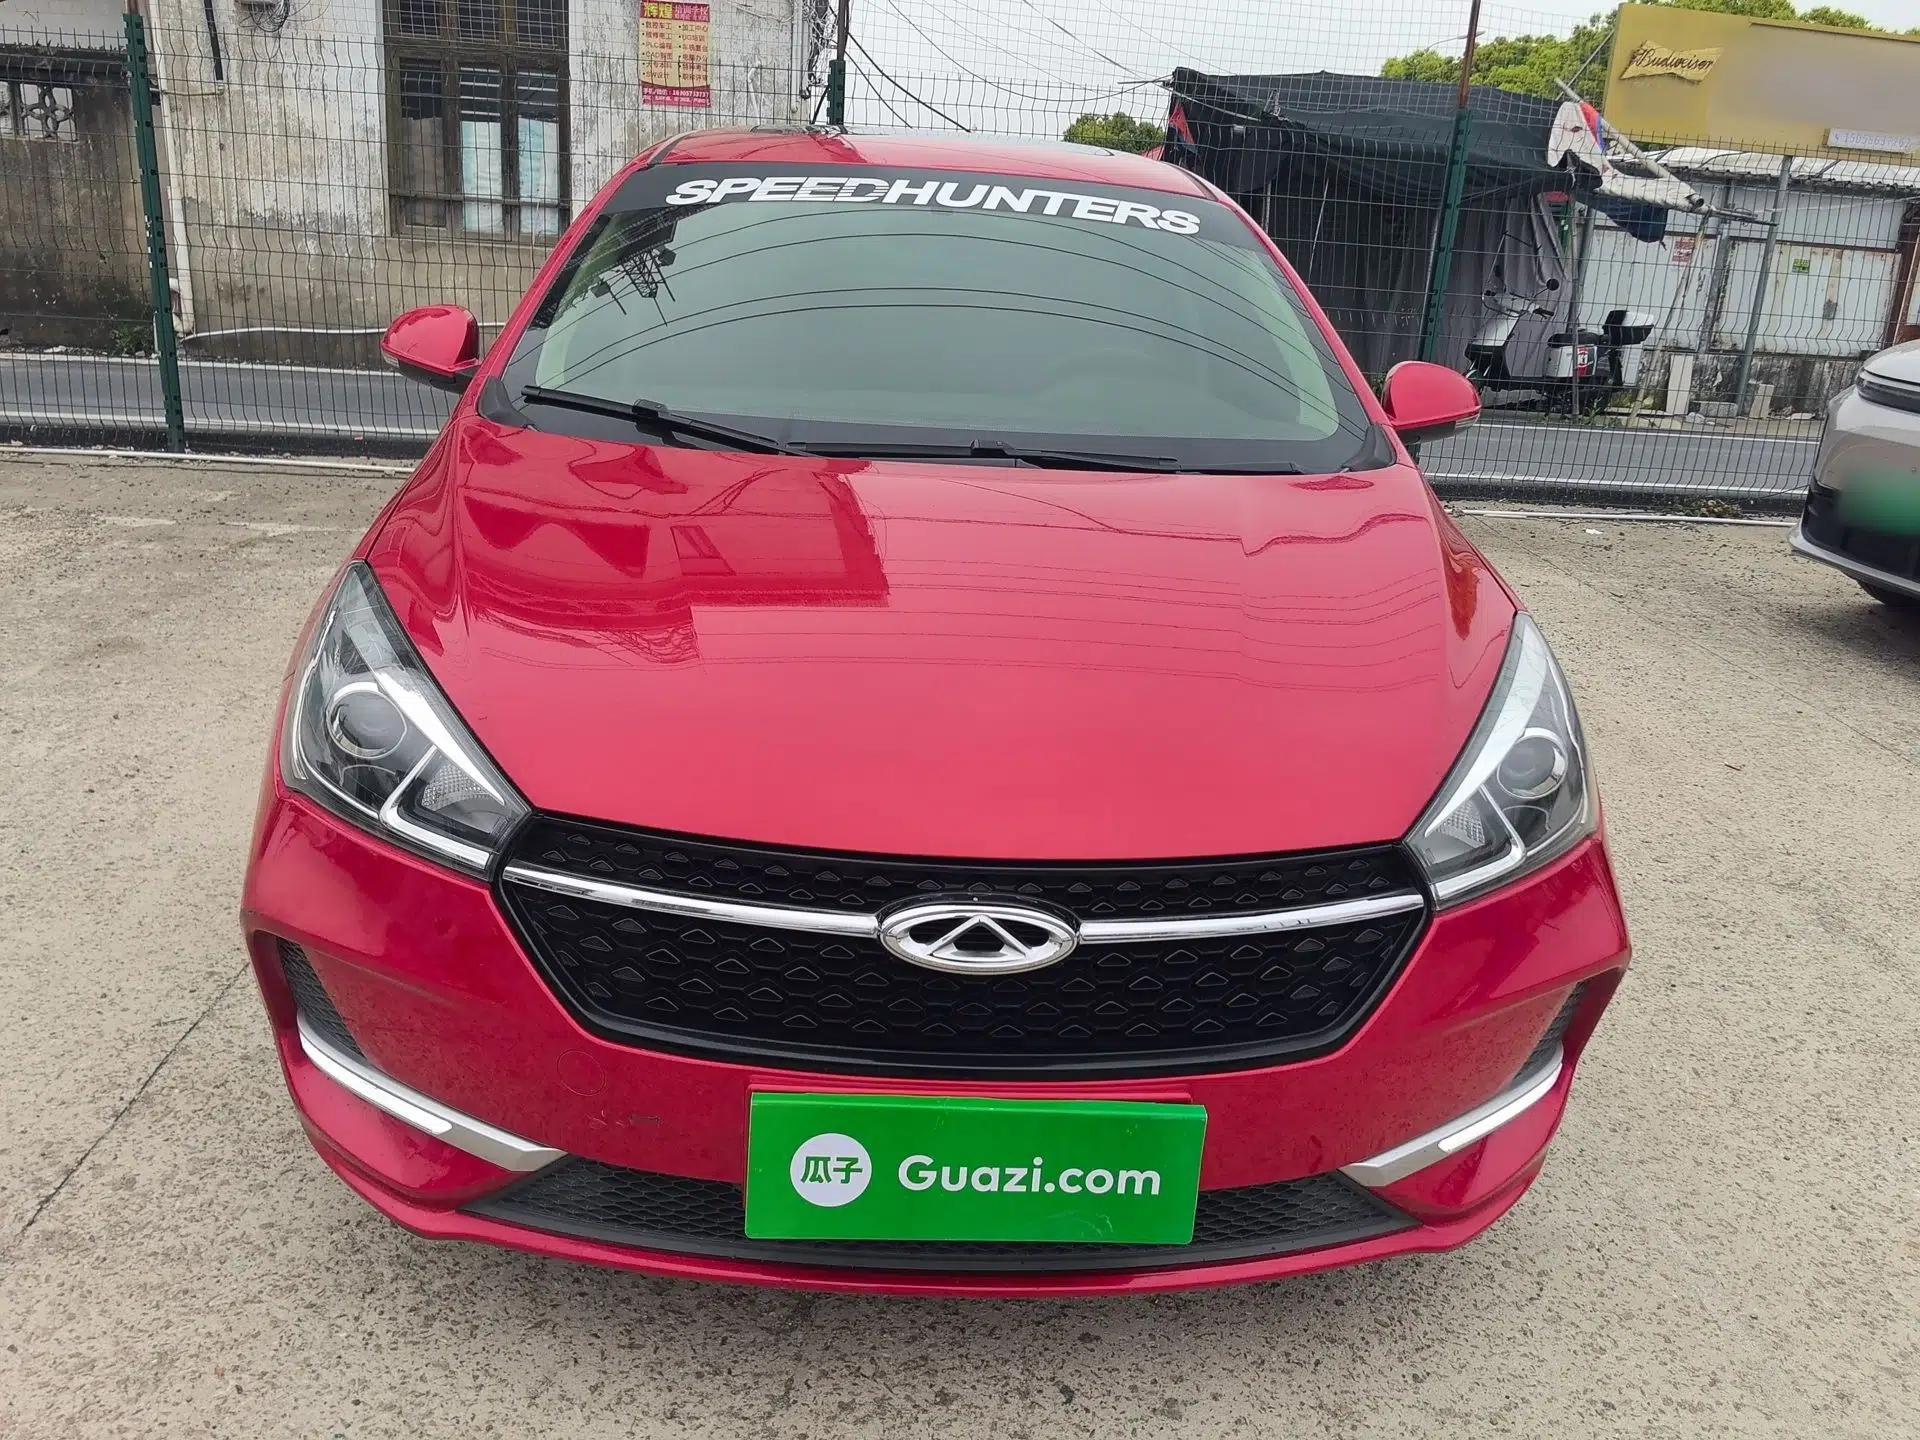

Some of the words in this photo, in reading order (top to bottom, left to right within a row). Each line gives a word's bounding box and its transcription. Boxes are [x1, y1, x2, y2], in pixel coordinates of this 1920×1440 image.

[682, 24, 708, 32] 加工中心
[1632, 48, 1714, 71] Budweiser
[666, 177, 1200, 235] SPEEDHUNTERS
[801, 1156, 863, 1184] 瓜子
[899, 1155, 1161, 1195] Guazi.com
